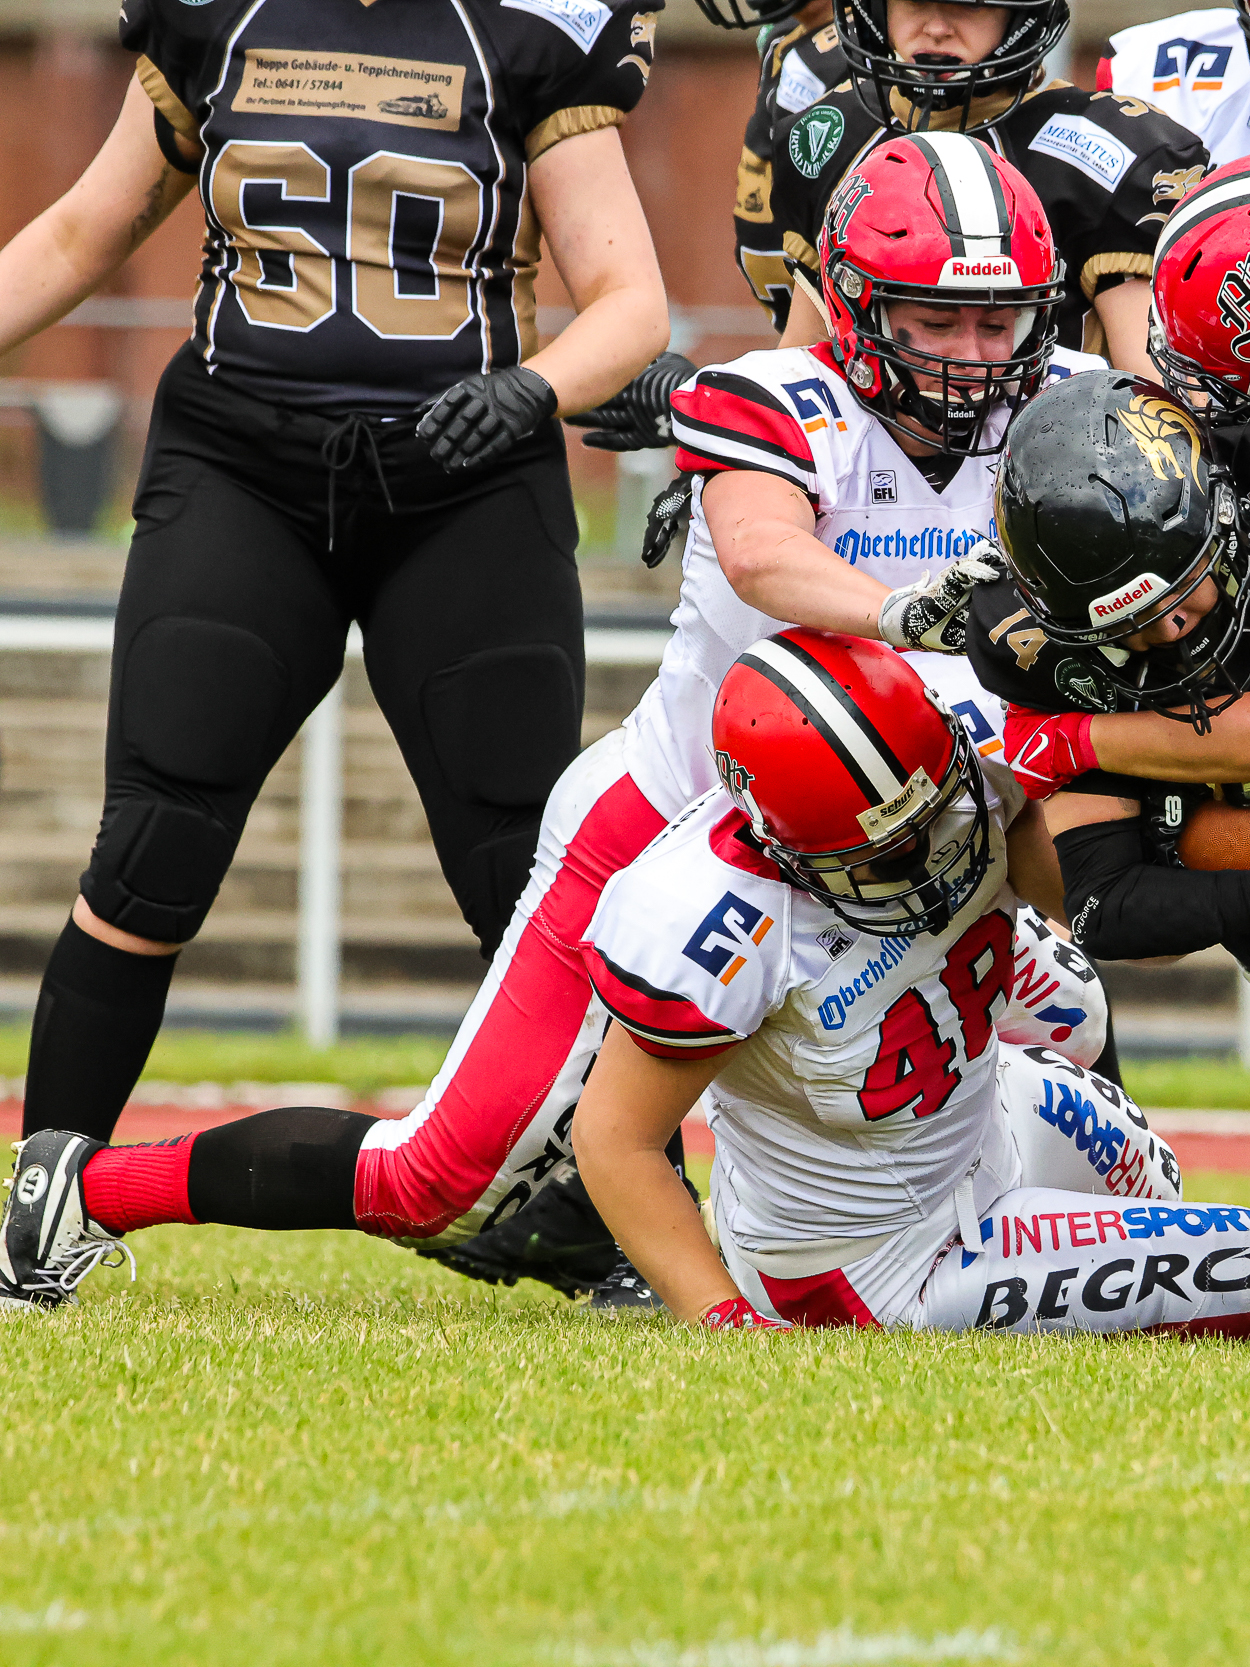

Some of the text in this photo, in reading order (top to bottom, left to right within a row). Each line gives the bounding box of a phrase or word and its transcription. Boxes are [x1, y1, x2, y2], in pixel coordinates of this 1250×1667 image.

[255, 58, 289, 71] Hoppe
[357, 62, 453, 86] Teppichreinigung
[275, 78, 301, 90] 0641
[308, 79, 343, 91] 57844
[296, 98, 366, 112] Reinigungsfragen
[1043, 125, 1119, 169] MERCATUS
[208, 139, 484, 340] 60
[952, 261, 1012, 276] Riddell
[873, 487, 895, 500] GFL
[1093, 579, 1154, 618] Riddell
[988, 607, 1050, 672] 14
[829, 932, 853, 957] GFL
